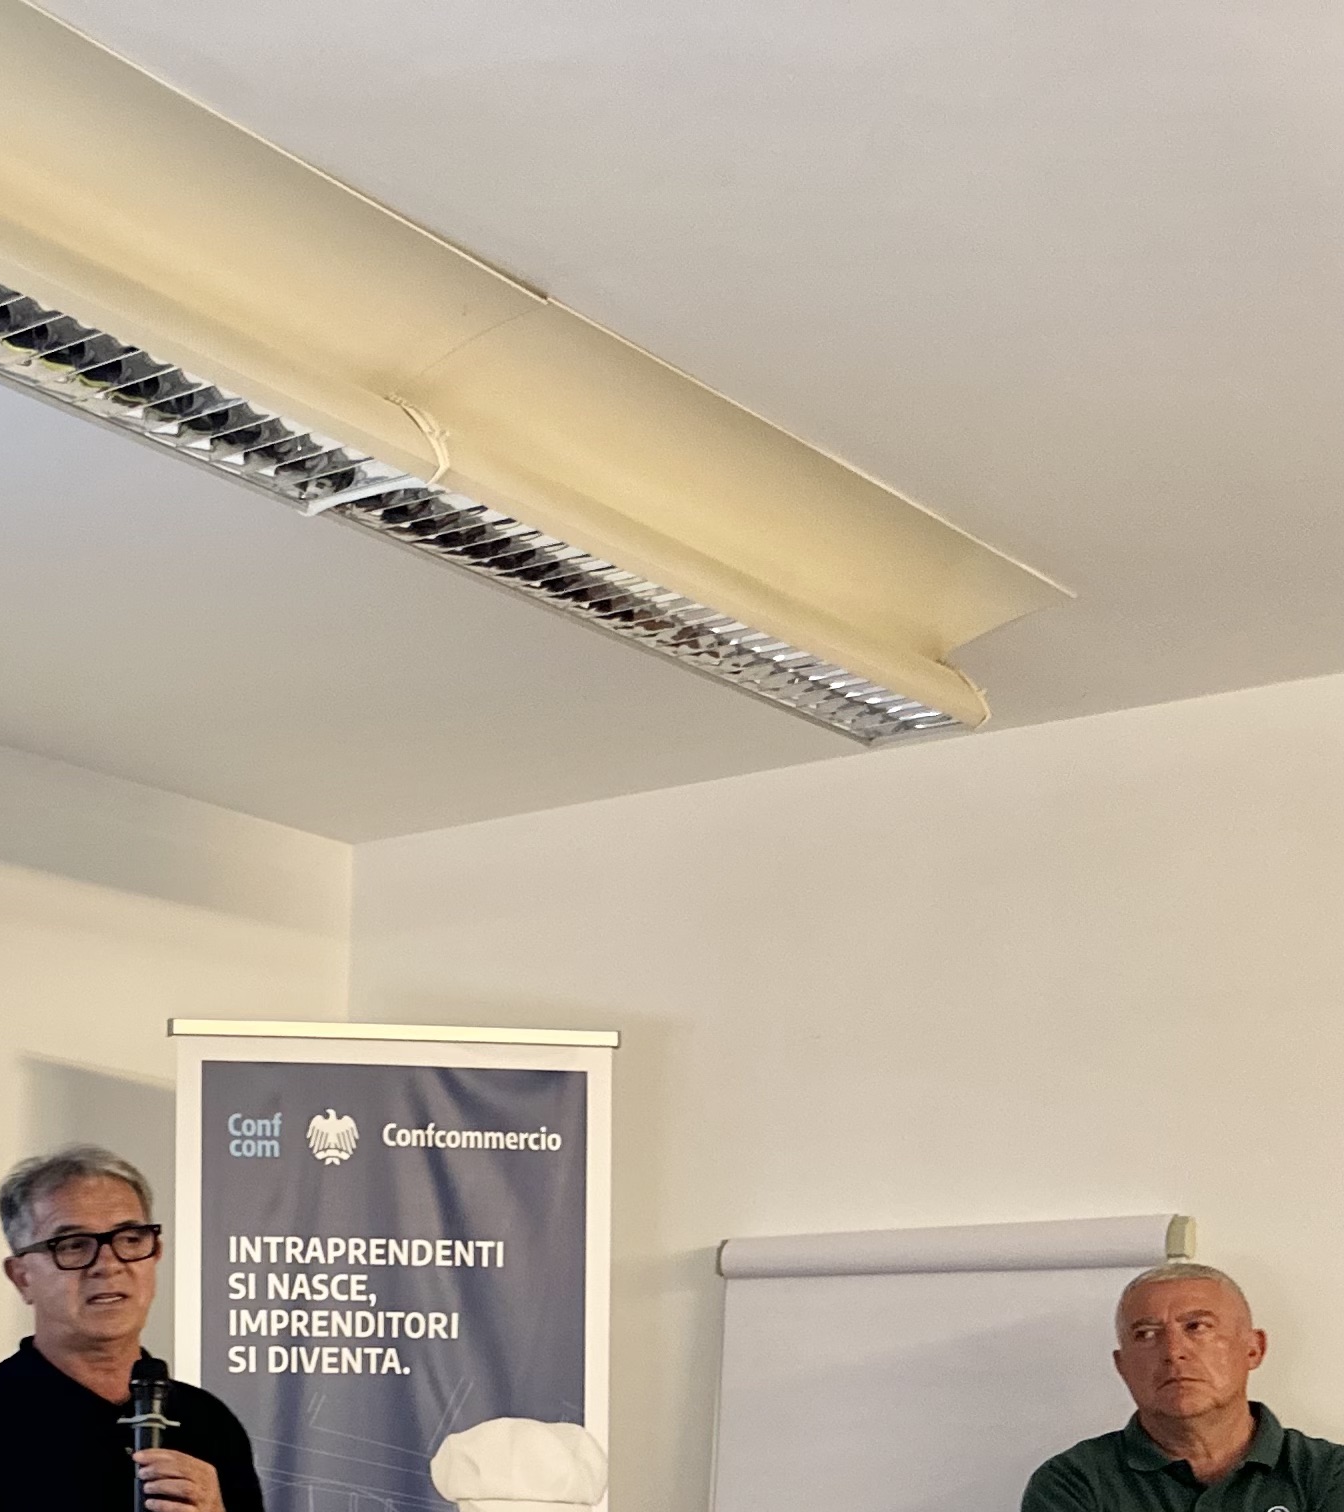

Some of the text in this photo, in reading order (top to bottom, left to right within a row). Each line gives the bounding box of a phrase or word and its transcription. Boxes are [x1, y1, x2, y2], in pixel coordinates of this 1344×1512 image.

[228, 1112, 282, 1137] Conf
[382, 1122, 562, 1152] Confcommercio
[229, 1139, 280, 1158] com
[228, 1235, 505, 1268] INTRAPRENDENTI
[228, 1271, 377, 1307] SI NASCE,
[228, 1309, 460, 1340] IMPRENDITORI
[228, 1345, 411, 1375] SI DIVENTA.
